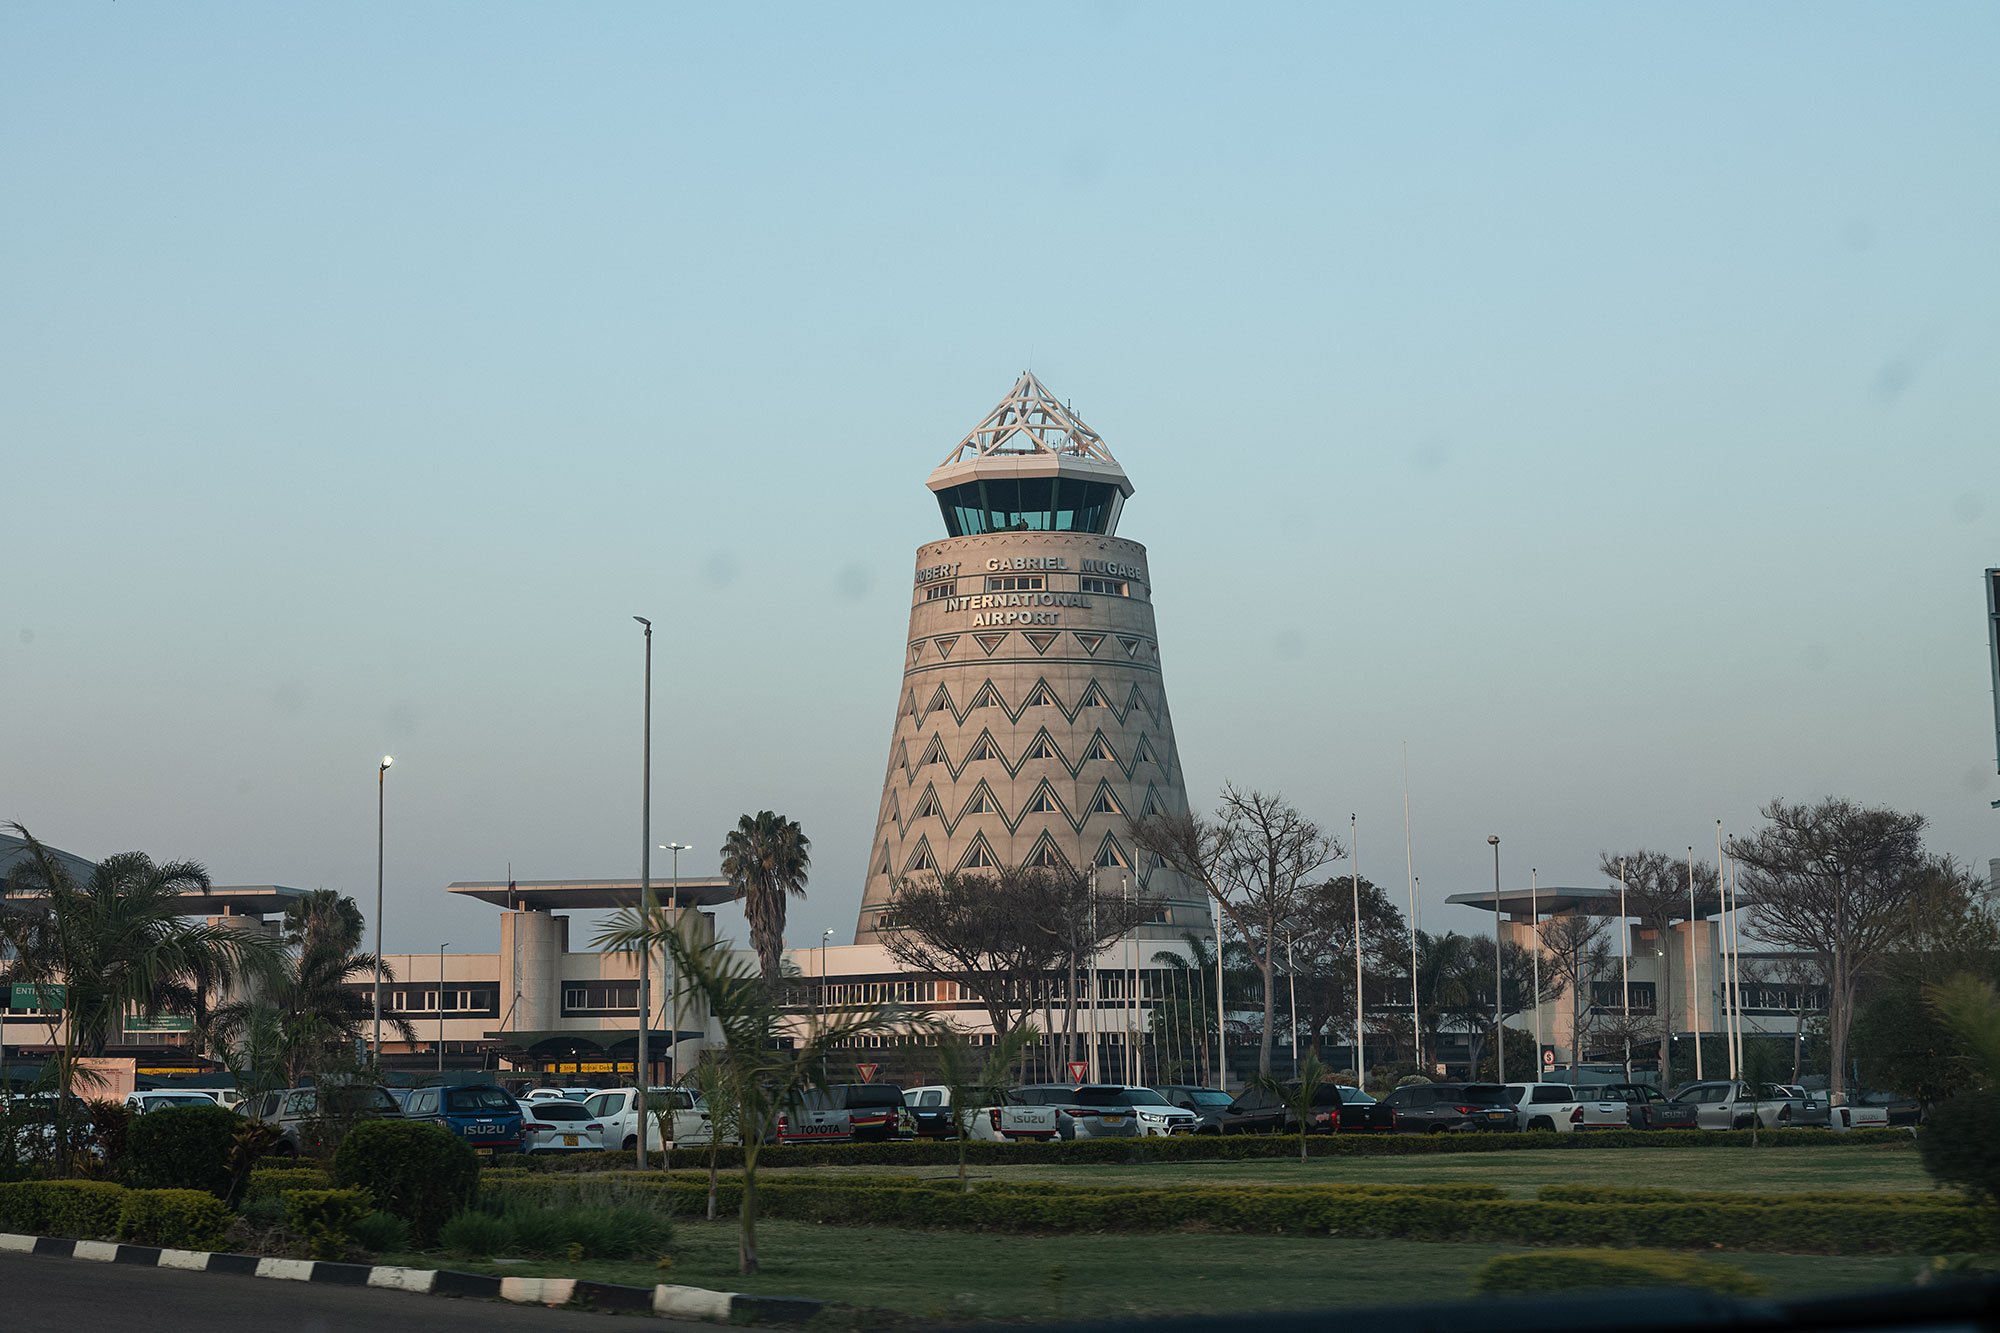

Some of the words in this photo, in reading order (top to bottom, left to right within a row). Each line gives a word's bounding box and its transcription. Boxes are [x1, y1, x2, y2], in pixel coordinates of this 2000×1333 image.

[986, 556, 1068, 572] GABRIEL
[1081, 558, 1142, 581] MUGABE
[944, 592, 1092, 613] INTERNATIONAL
[972, 611, 1059, 627] AIRPORT
[1013, 1115, 1045, 1124] ISUZU
[1661, 1110, 1688, 1119] ISUZU
[463, 1125, 506, 1135] ISUZU
[799, 1124, 841, 1135] TOYOTA
